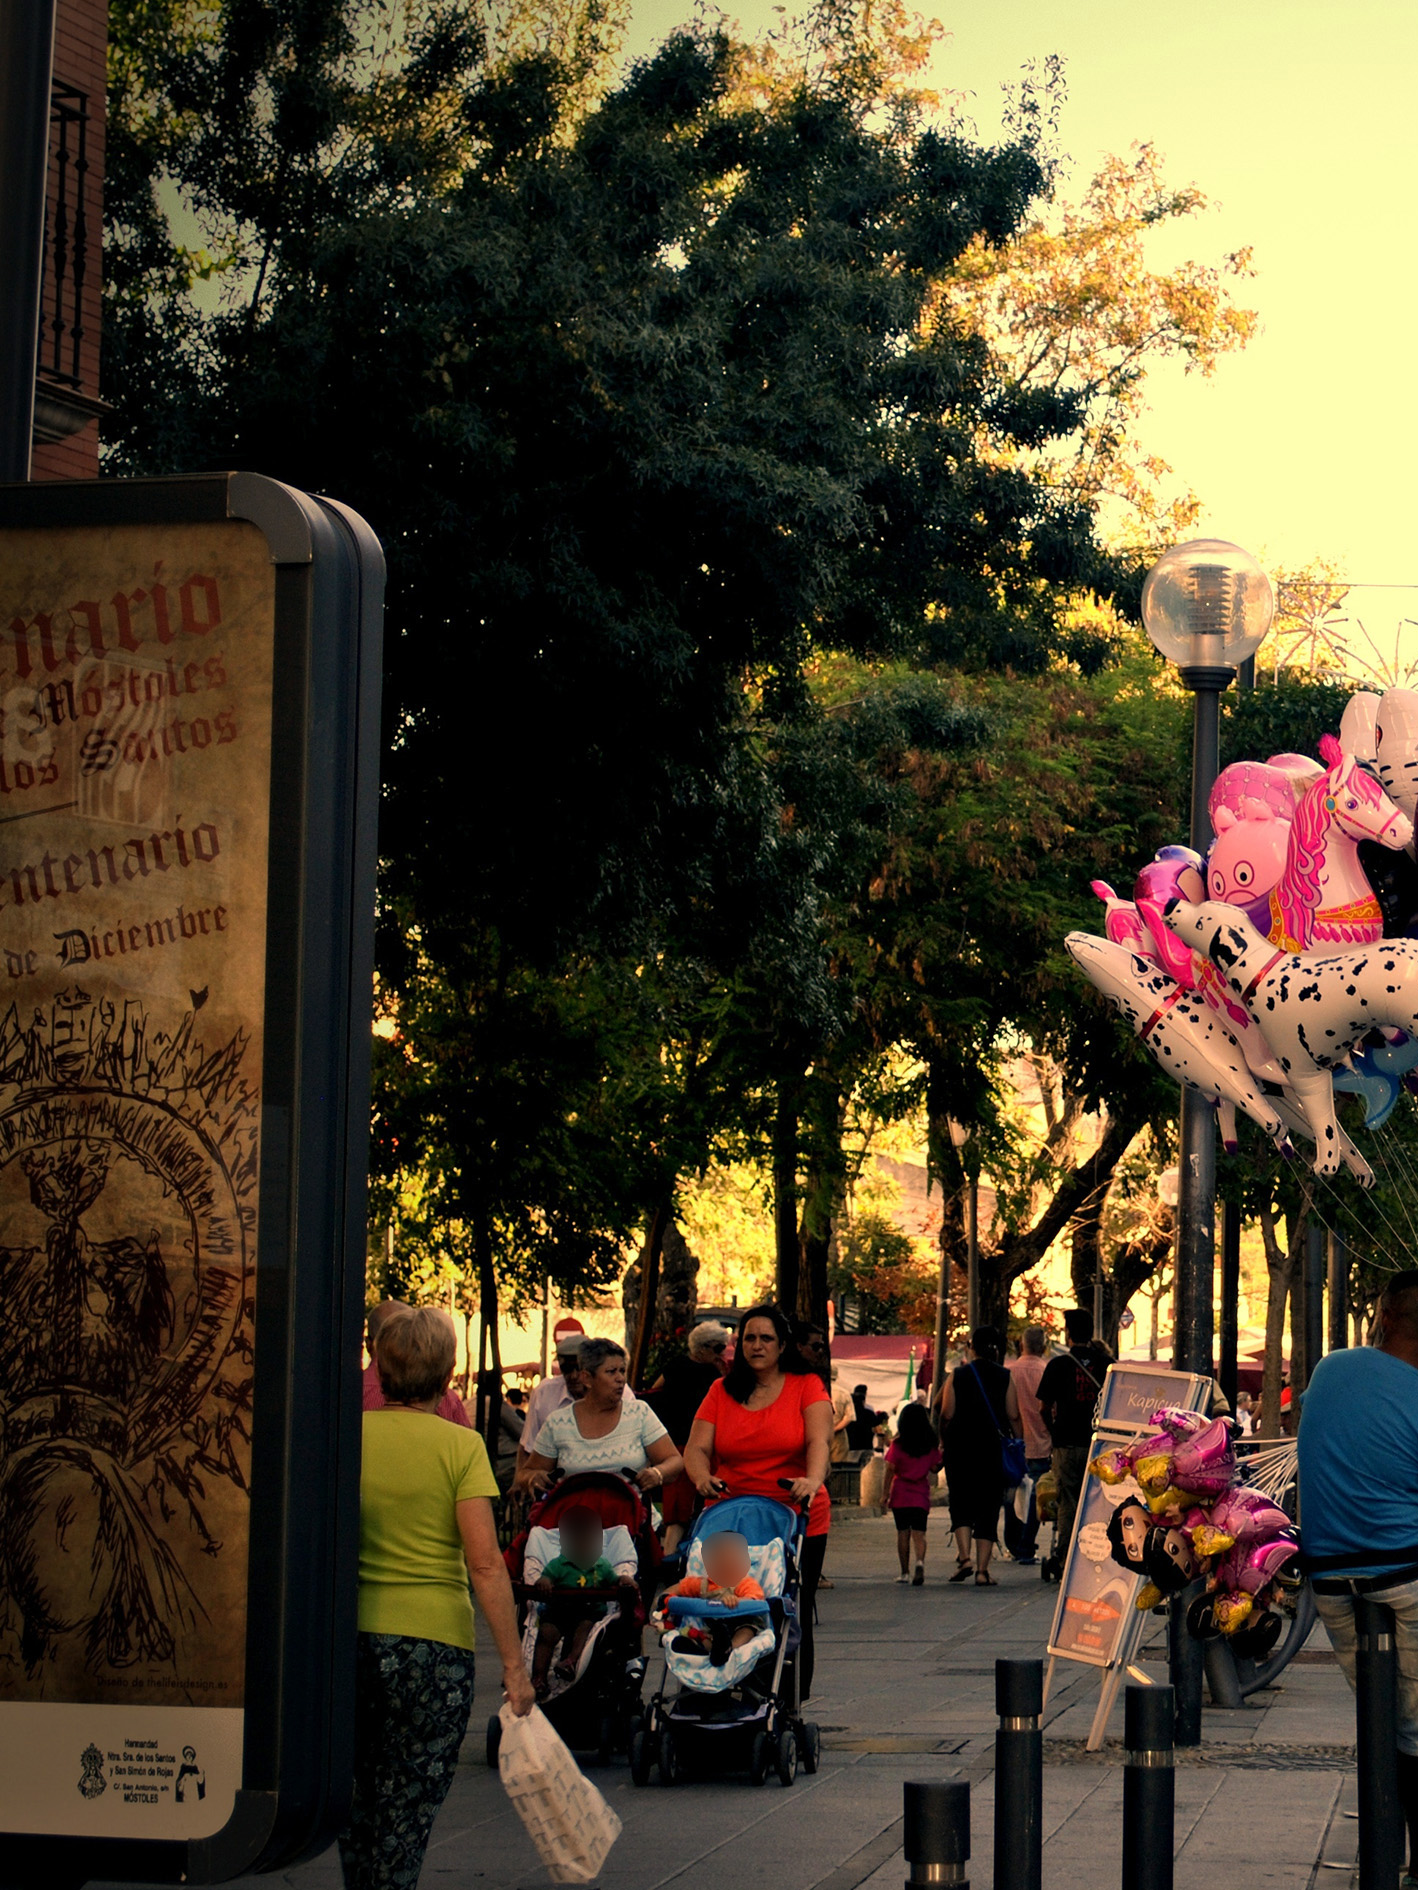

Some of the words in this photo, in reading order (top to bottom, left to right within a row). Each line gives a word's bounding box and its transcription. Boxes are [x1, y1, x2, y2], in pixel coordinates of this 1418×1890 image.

[0, 560, 221, 678] nario
[29, 651, 227, 737] Móstoles
[80, 706, 239, 777] Santos
[4, 948, 38, 979] de
[53, 905, 228, 971] Diciembre
[115, 1766, 126, 1775] San
[148, 1767, 155, 1776] de
[156, 1767, 174, 1778] Rojas
[123, 1752, 135, 1762] Sra.
[136, 1753, 144, 1762] de
[145, 1753, 154, 1762] los
[155, 1753, 176, 1763] Santos
[124, 1792, 159, 1803] MÓSTOLES
